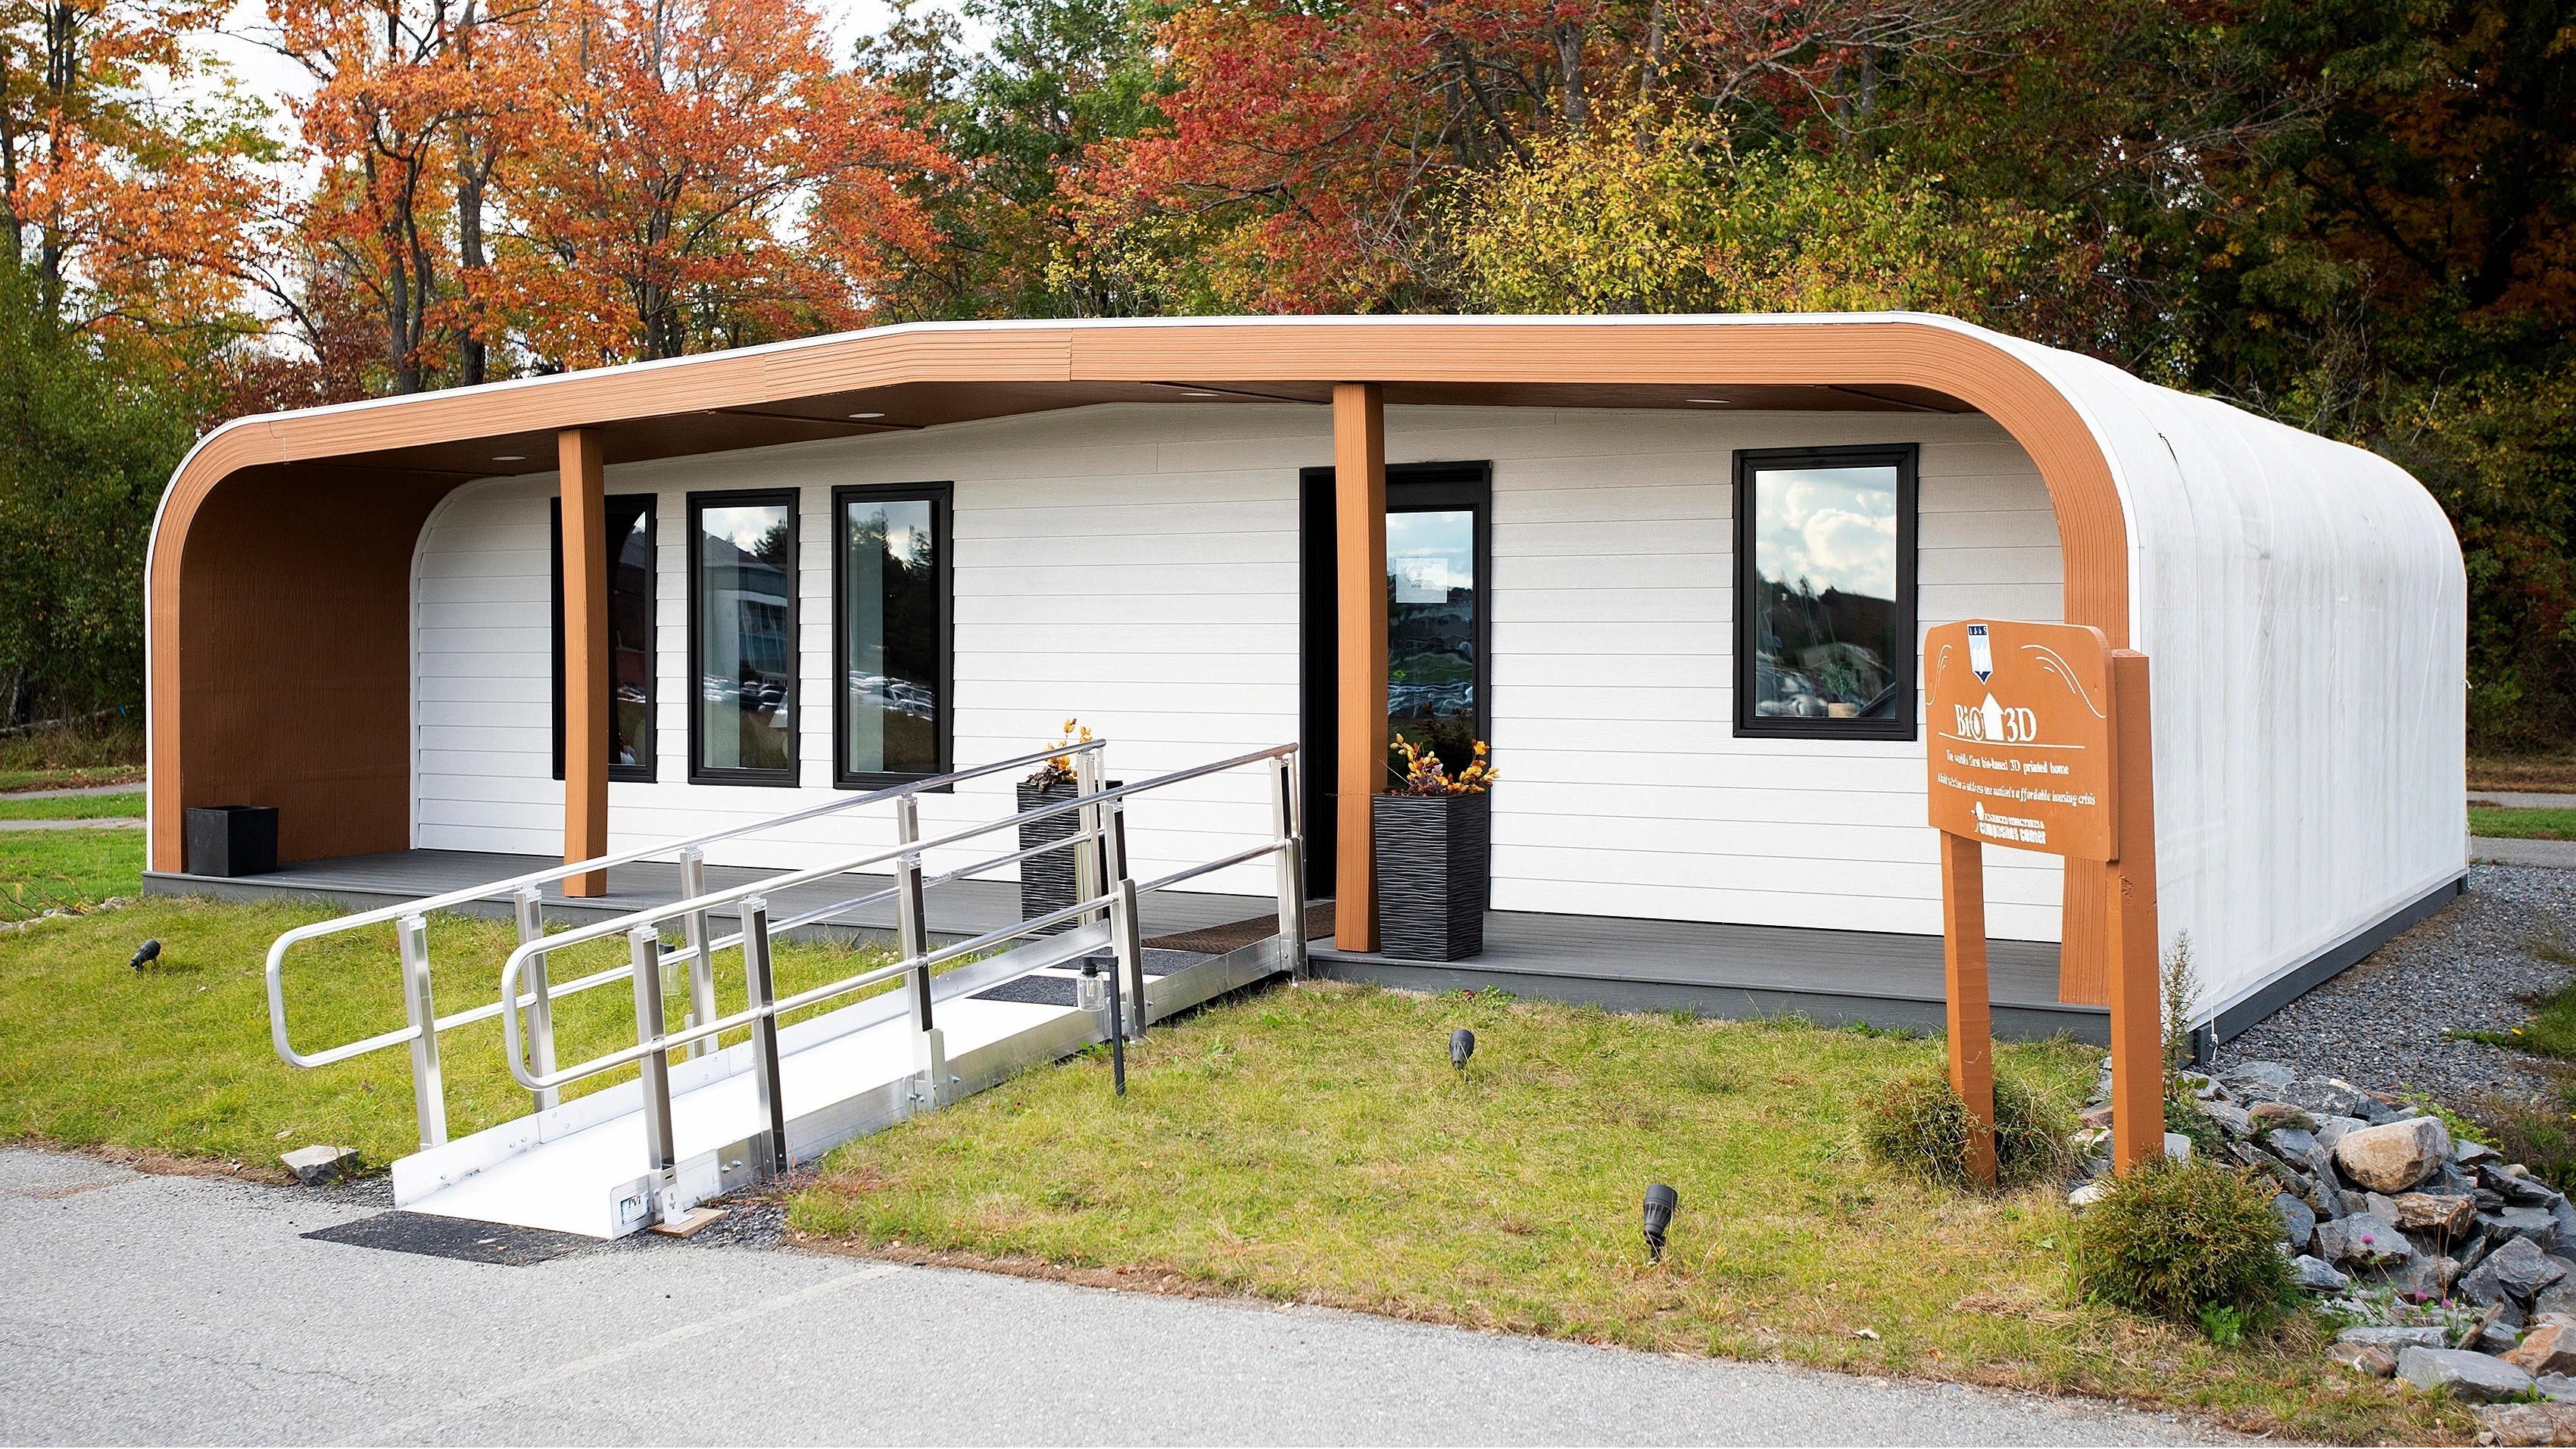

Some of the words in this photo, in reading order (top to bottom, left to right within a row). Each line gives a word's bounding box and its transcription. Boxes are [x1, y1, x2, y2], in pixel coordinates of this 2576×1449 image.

[2004, 706, 2037, 743] 3D
[1981, 756, 2008, 771] bio-based
[2009, 759, 2021, 772] 3D
[2022, 760, 2047, 775] printed
[2049, 761, 2069, 775] home
[2015, 787, 2051, 803] affordable
[2051, 790, 2077, 808] housing
[2078, 792, 2096, 806] crisis
